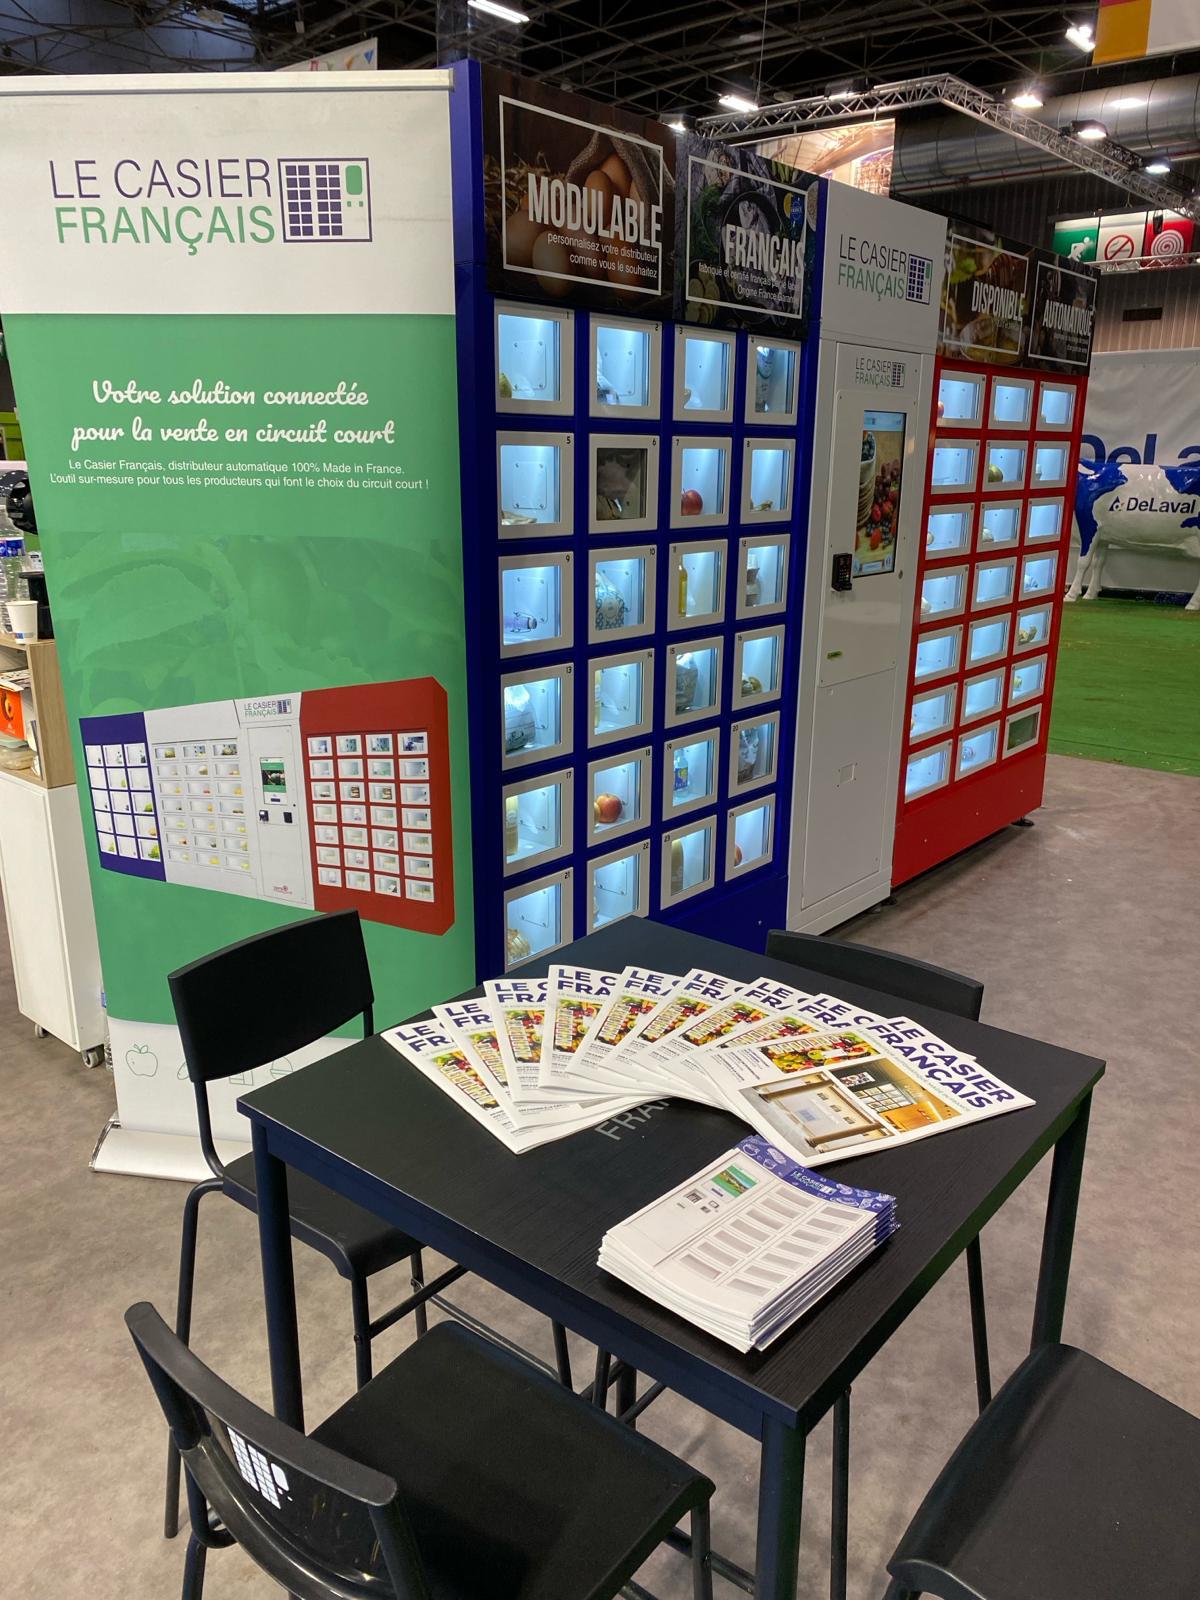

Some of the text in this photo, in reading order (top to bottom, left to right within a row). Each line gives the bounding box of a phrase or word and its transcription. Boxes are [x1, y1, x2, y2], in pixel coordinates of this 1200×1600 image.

[49, 158, 272, 199] LE CASIER
[528, 172, 663, 249] MODULABLE
[55, 205, 275, 256] FRANÇAIS
[547, 233, 658, 263] personnalisez votre distributeur
[725, 223, 805, 281] FRANÇAIS
[839, 233, 907, 274] LE CASIER
[569, 253, 657, 279] comme vous le souhaitez
[838, 263, 905, 302] FRANÇAIS
[759, 289, 776, 300] France
[971, 281, 1025, 322] DISPONIBLE
[566, 311, 570, 320] 1
[1043, 299, 1094, 337] AUTOMATIQUE
[655, 323, 659, 331] 2
[679, 326, 683, 334] 3
[855, 357, 892, 373] LE CASIER
[855, 371, 891, 389] FRANÇAIS
[92, 378, 369, 406] Votre solution connectée
[71, 416, 395, 452] pour la vente en circuit court
[566, 436, 571, 445] 5
[652, 438, 657, 446] 6
[676, 438, 680, 446] 7
[68, 459, 405, 475] Le Casier Français, distributeur automatique 100% Made in France.
[50, 472, 429, 489] L'outil sur-mesure pour tous les producteurs qui font le choix du circuit court !
[1126, 497, 1196, 514] DeLaval
[566, 555, 570, 563] 9
[650, 548, 655, 556] 10
[566, 666, 572, 674] 13
[244, 701, 277, 711] LE CASIER
[244, 708, 277, 718] FRANÇAIS
[566, 771, 572, 779] 17
[558, 969, 591, 983] LE
[630, 970, 664, 985] LE
[692, 973, 728, 989] LE
[494, 982, 530, 992] LE
[756, 982, 794, 999] LE
[444, 1003, 482, 1017] LE
[814, 998, 852, 1016] LE
[395, 1025, 435, 1041] LE
[867, 1026, 993, 1109] FRANÇAIS
[888, 1020, 1015, 1103] LE CASIER
[594, 1101, 670, 1141] FRA
